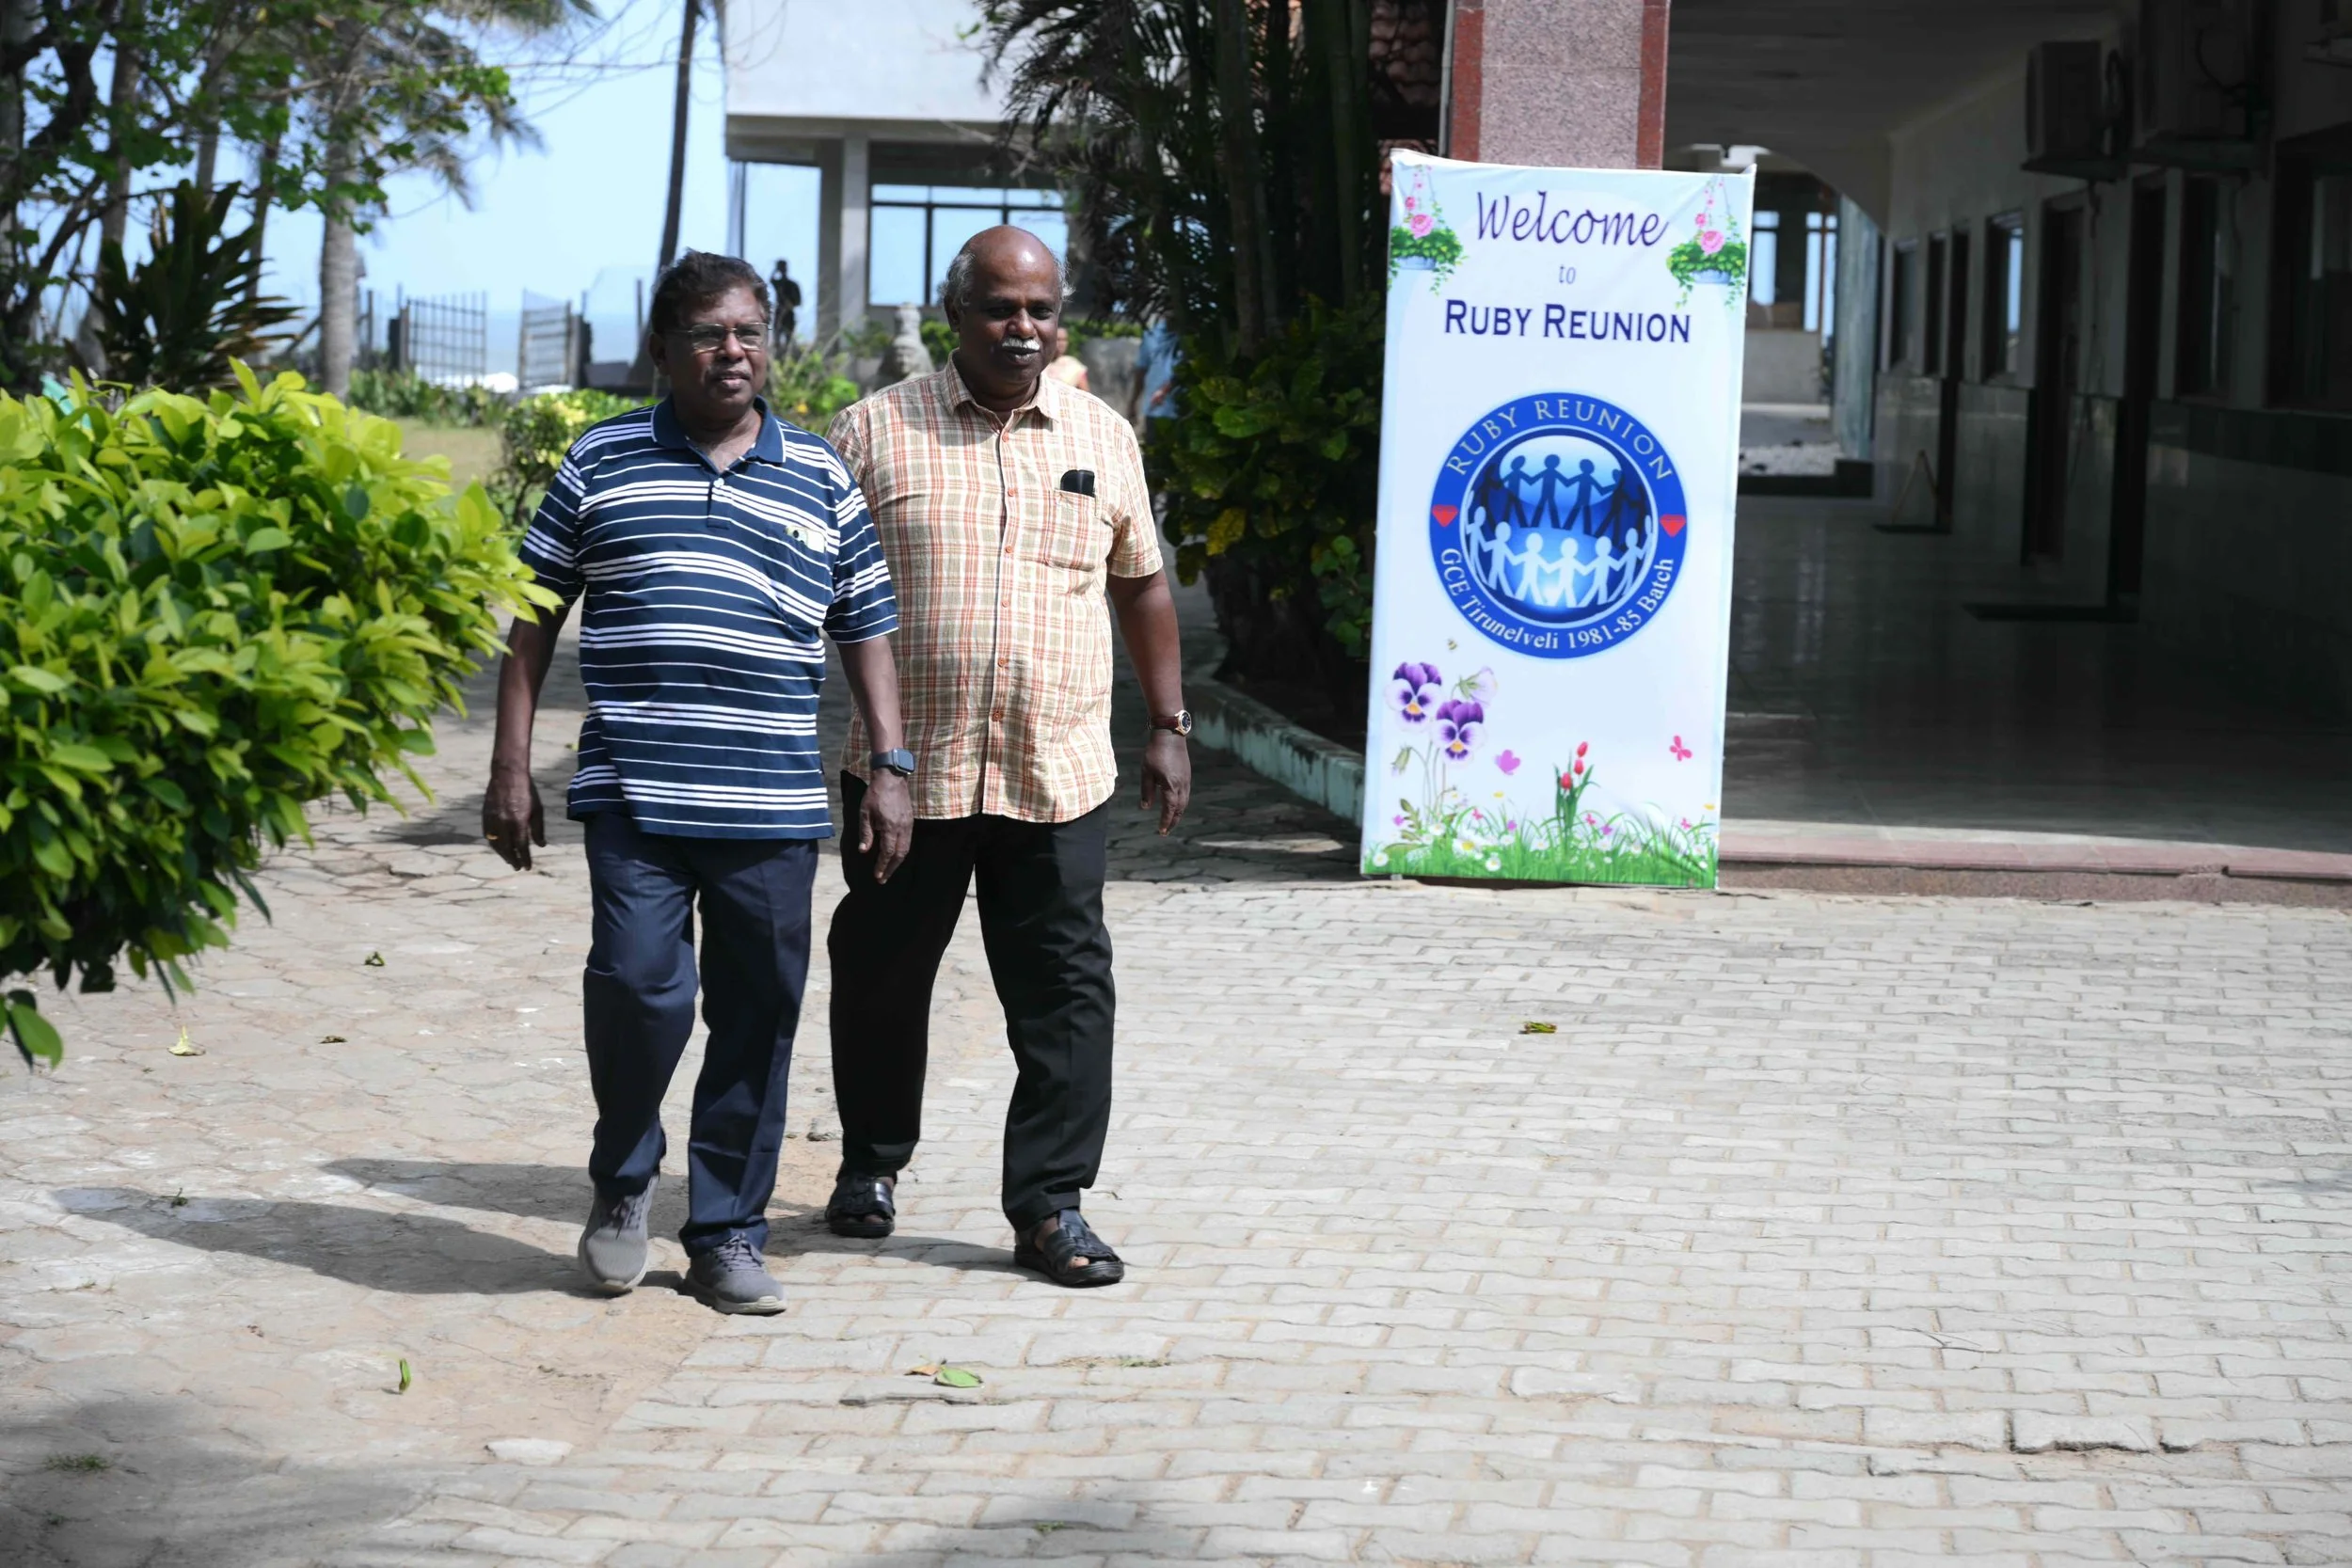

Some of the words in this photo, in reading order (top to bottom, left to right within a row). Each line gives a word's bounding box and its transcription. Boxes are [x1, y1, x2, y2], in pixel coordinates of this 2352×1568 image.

[1476, 190, 1669, 247] Welcome
[1558, 264, 1577, 284] to
[1444, 299, 1533, 338] RUBY
[1543, 304, 1692, 343] REUNION
[1446, 406, 1518, 476] RUBY
[1534, 399, 1673, 481] REUNION
[1440, 547, 1470, 596] GCE
[1461, 594, 1559, 649] Tirunelveli
[1568, 609, 1643, 648] 1981-85
[1637, 558, 1674, 612] Batch
